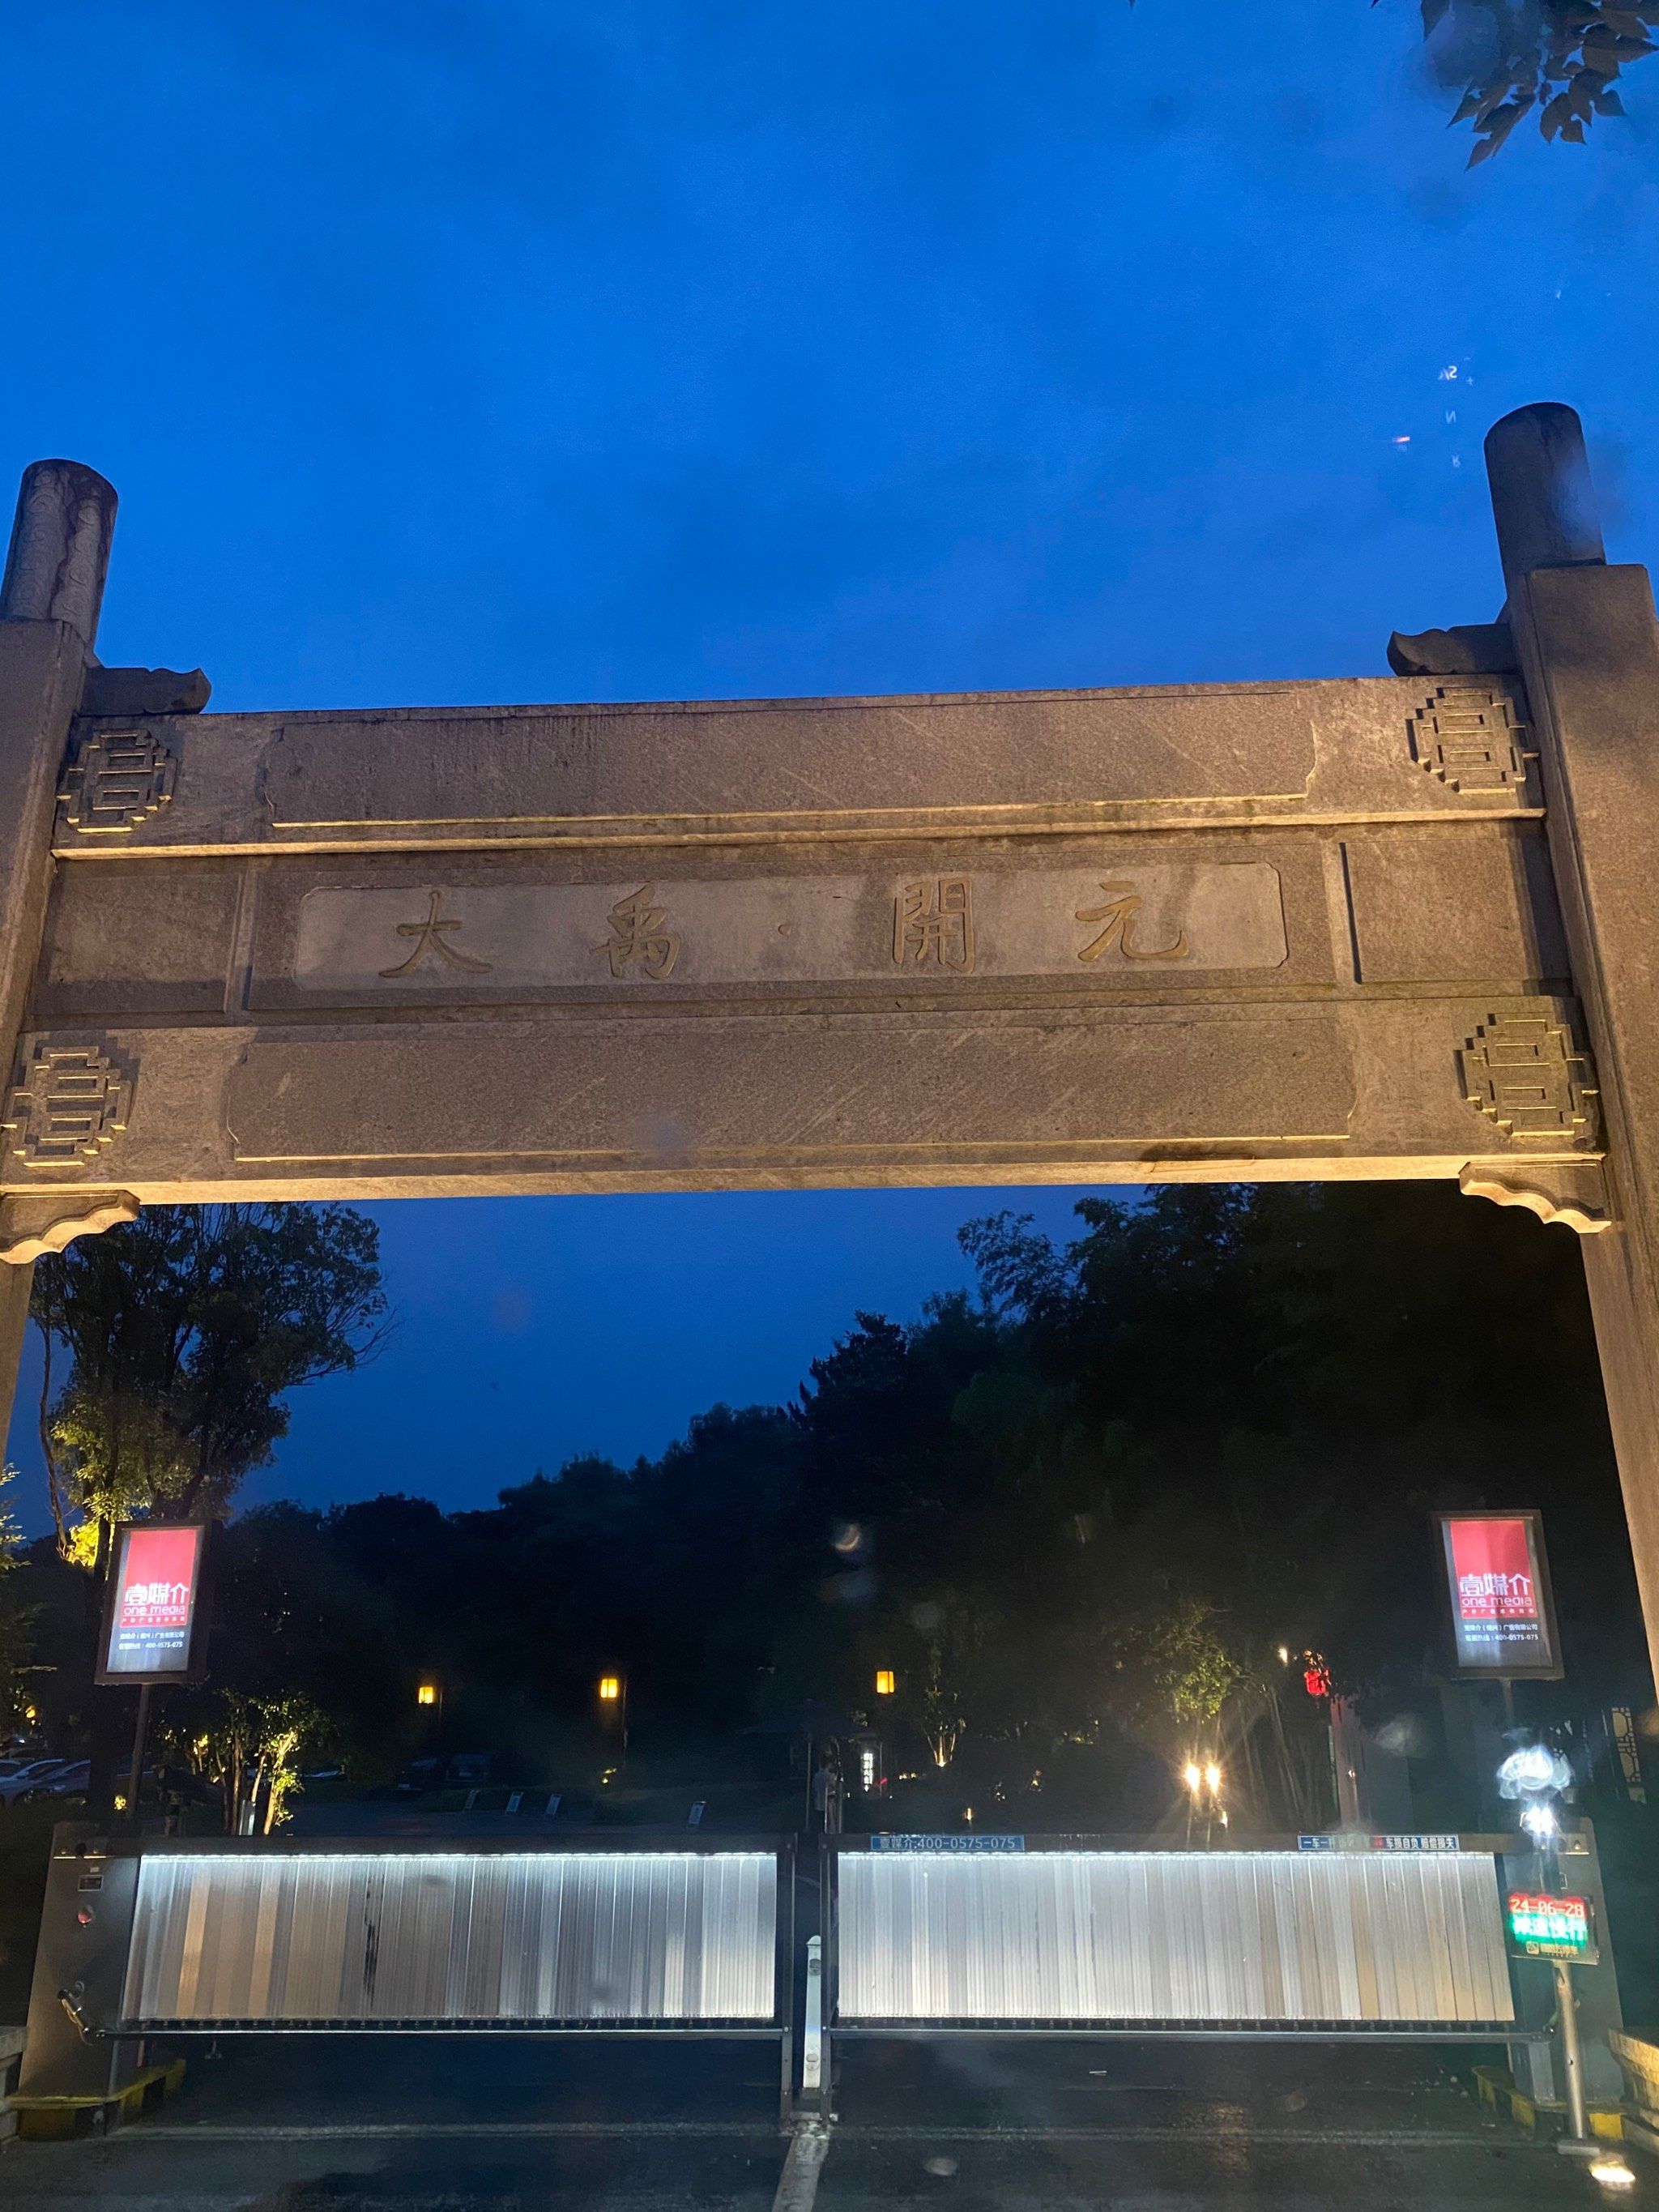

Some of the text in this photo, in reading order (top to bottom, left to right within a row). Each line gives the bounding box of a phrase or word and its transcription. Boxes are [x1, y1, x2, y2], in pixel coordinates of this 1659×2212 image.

[124, 1582, 190, 1606] 壹媒介
[1459, 1573, 1531, 1597] 壹媒介
[124, 1604, 186, 1616] one media
[1461, 1595, 1533, 1606] one media
[1510, 1898, 1584, 1918] 24-06-28
